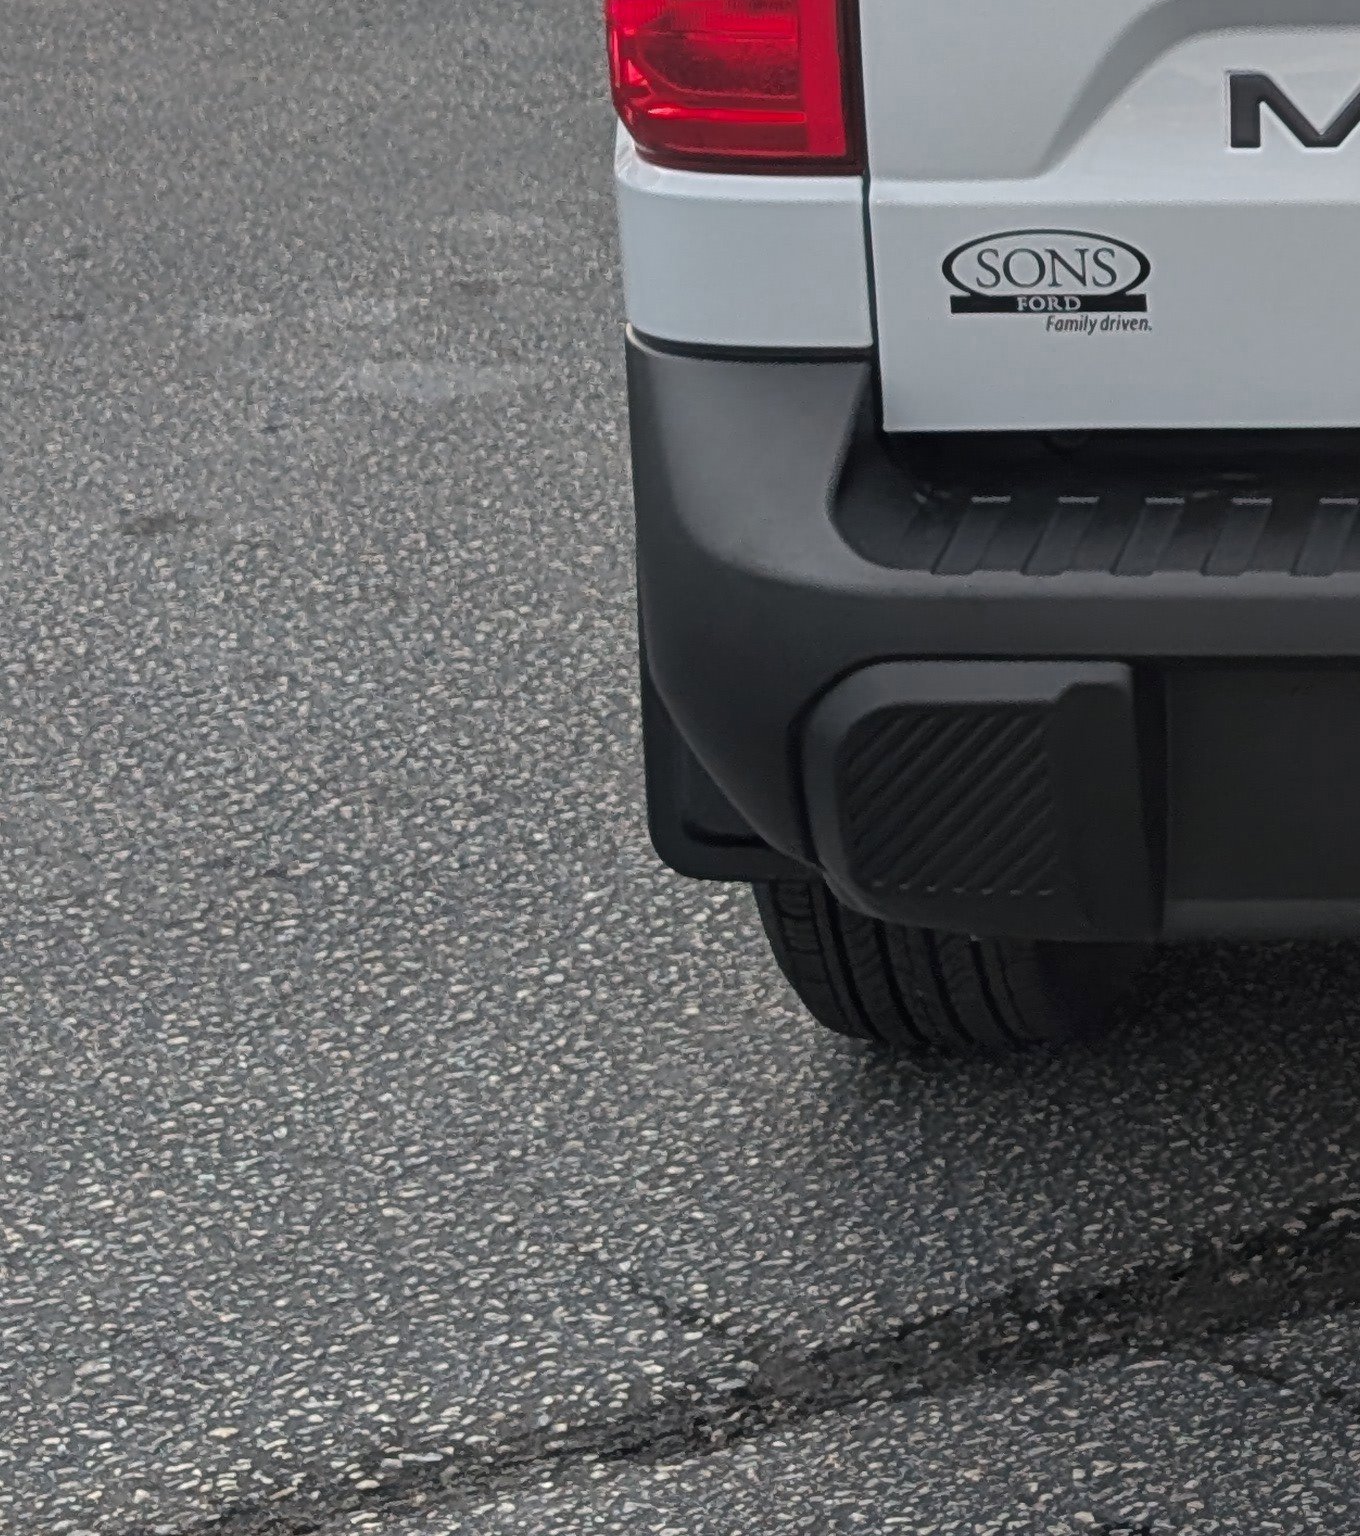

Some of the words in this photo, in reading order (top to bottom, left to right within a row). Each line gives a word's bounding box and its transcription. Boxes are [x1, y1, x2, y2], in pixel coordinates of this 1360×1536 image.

[976, 248, 1118, 288] SONS
[1016, 296, 1082, 311] FORD
[1046, 315, 1097, 336] Family
[1100, 315, 1152, 331] driven.
